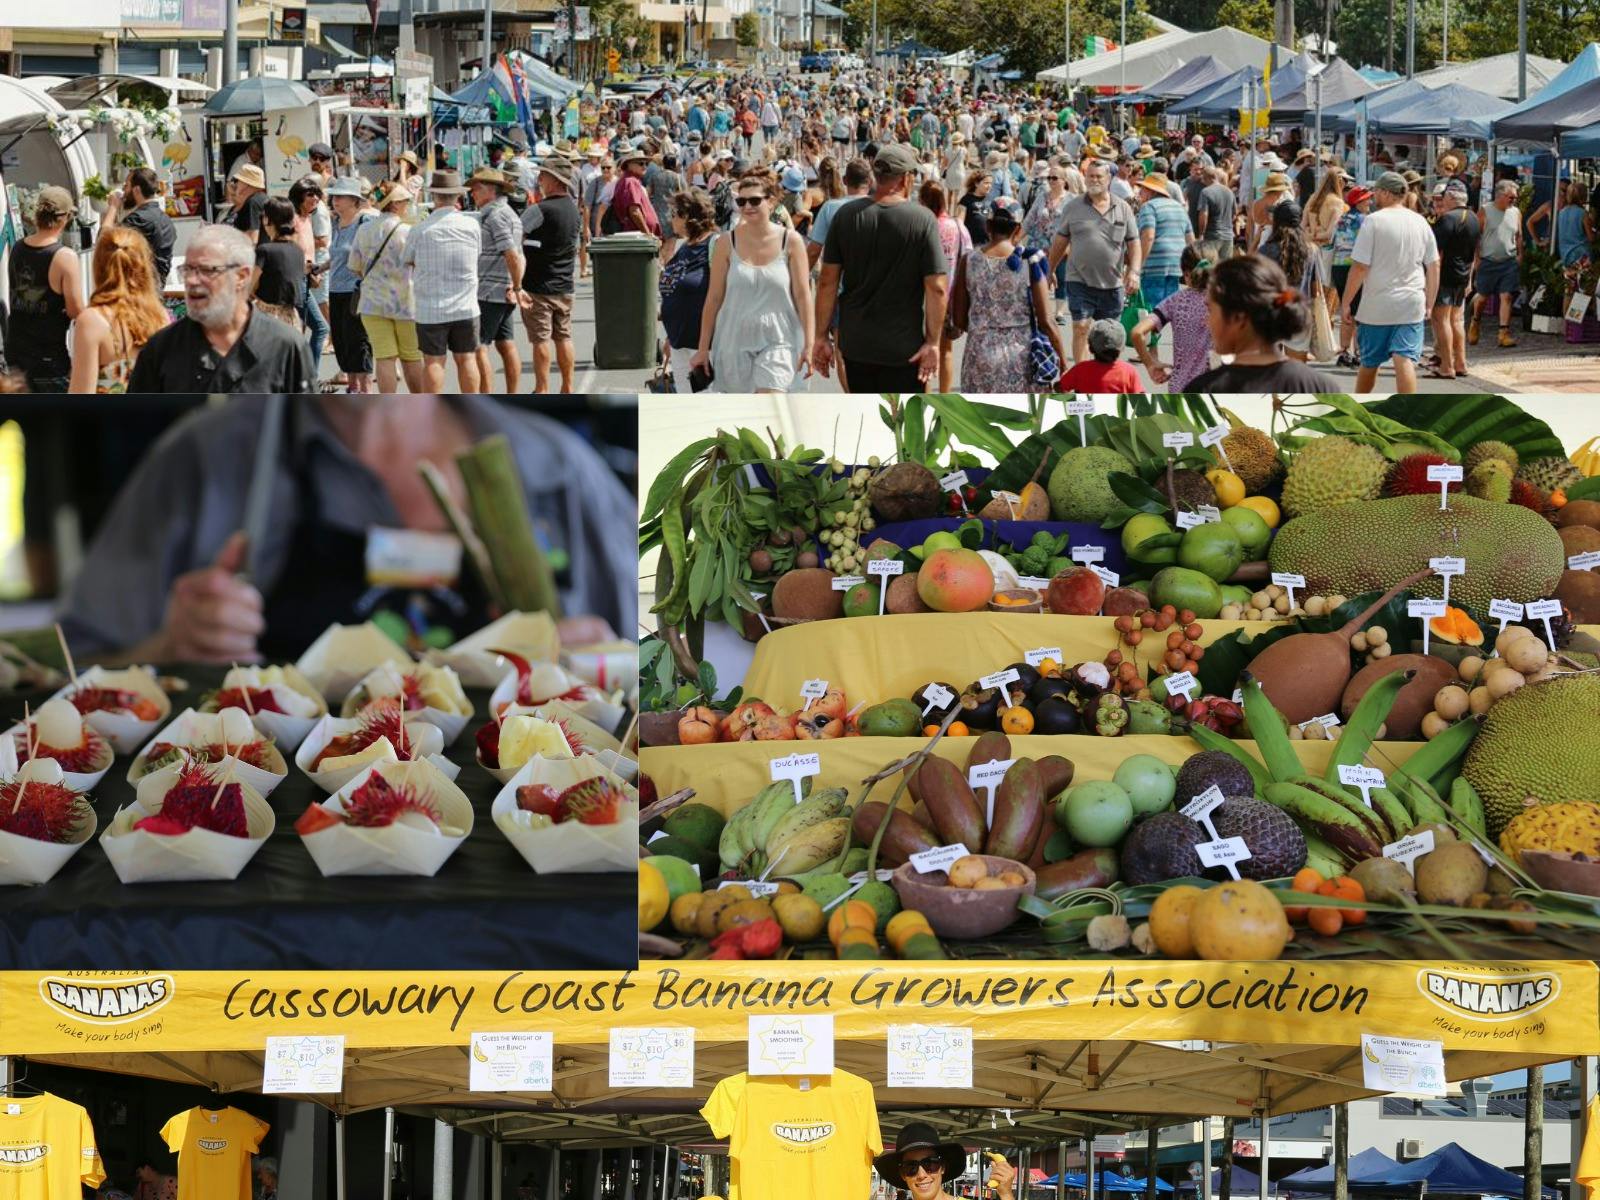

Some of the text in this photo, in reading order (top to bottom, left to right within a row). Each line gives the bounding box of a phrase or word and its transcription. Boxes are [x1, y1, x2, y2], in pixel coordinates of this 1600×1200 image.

[775, 756, 818, 768] DUCASSE
[1211, 843, 1230, 851] SAGO
[47, 979, 166, 1018] BANANAS
[223, 965, 1369, 1031] Cassowary Coast Banana Growers Association
[1427, 973, 1552, 1014] BANANAS
[55, 1022, 83, 1039] Make
[85, 1034, 111, 1043] your
[113, 1030, 140, 1041] body
[1432, 1016, 1462, 1034] Make
[1463, 1029, 1492, 1039] your
[1493, 1026, 1521, 1040] body
[673, 1038, 685, 1047] $6
[900, 1042, 911, 1051] $7
[952, 1038, 963, 1047] $6
[646, 1045, 663, 1054] $10
[925, 1045, 942, 1054] $10
[299, 1053, 316, 1062] $10
[775, 1124, 831, 1143] BANANAS
[0, 1145, 48, 1164] ANANAS
